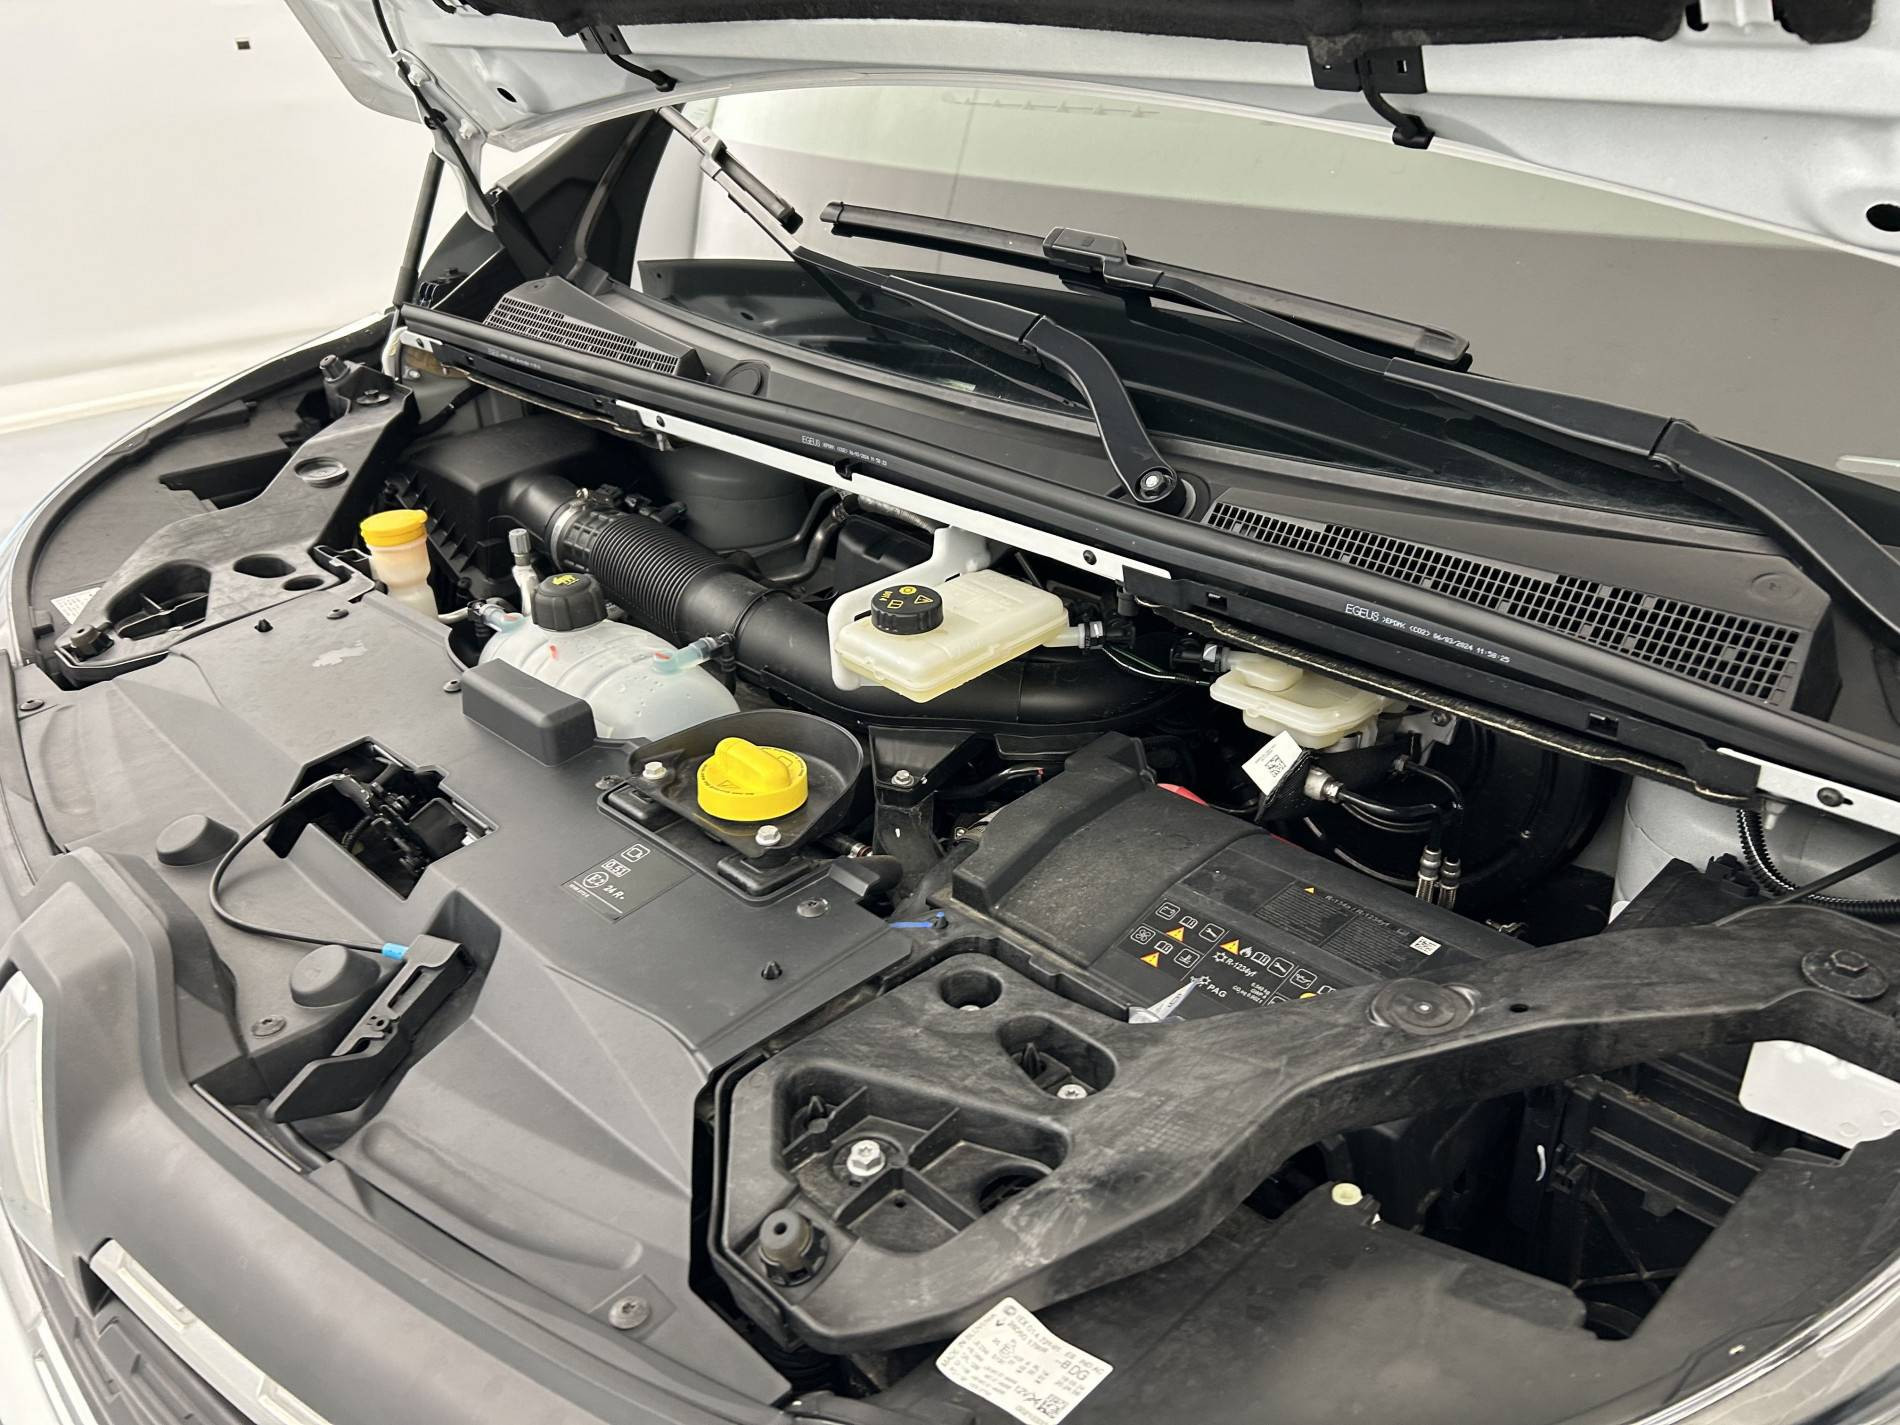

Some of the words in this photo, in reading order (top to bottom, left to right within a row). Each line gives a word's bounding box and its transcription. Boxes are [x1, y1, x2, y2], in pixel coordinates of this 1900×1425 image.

[1346, 603, 1380, 622] EGEUS
[607, 861, 627, 875] 0.51
[603, 884, 617, 895] 24
[1225, 957, 1258, 978] R-1234yf
[1207, 983, 1228, 998] PAG
